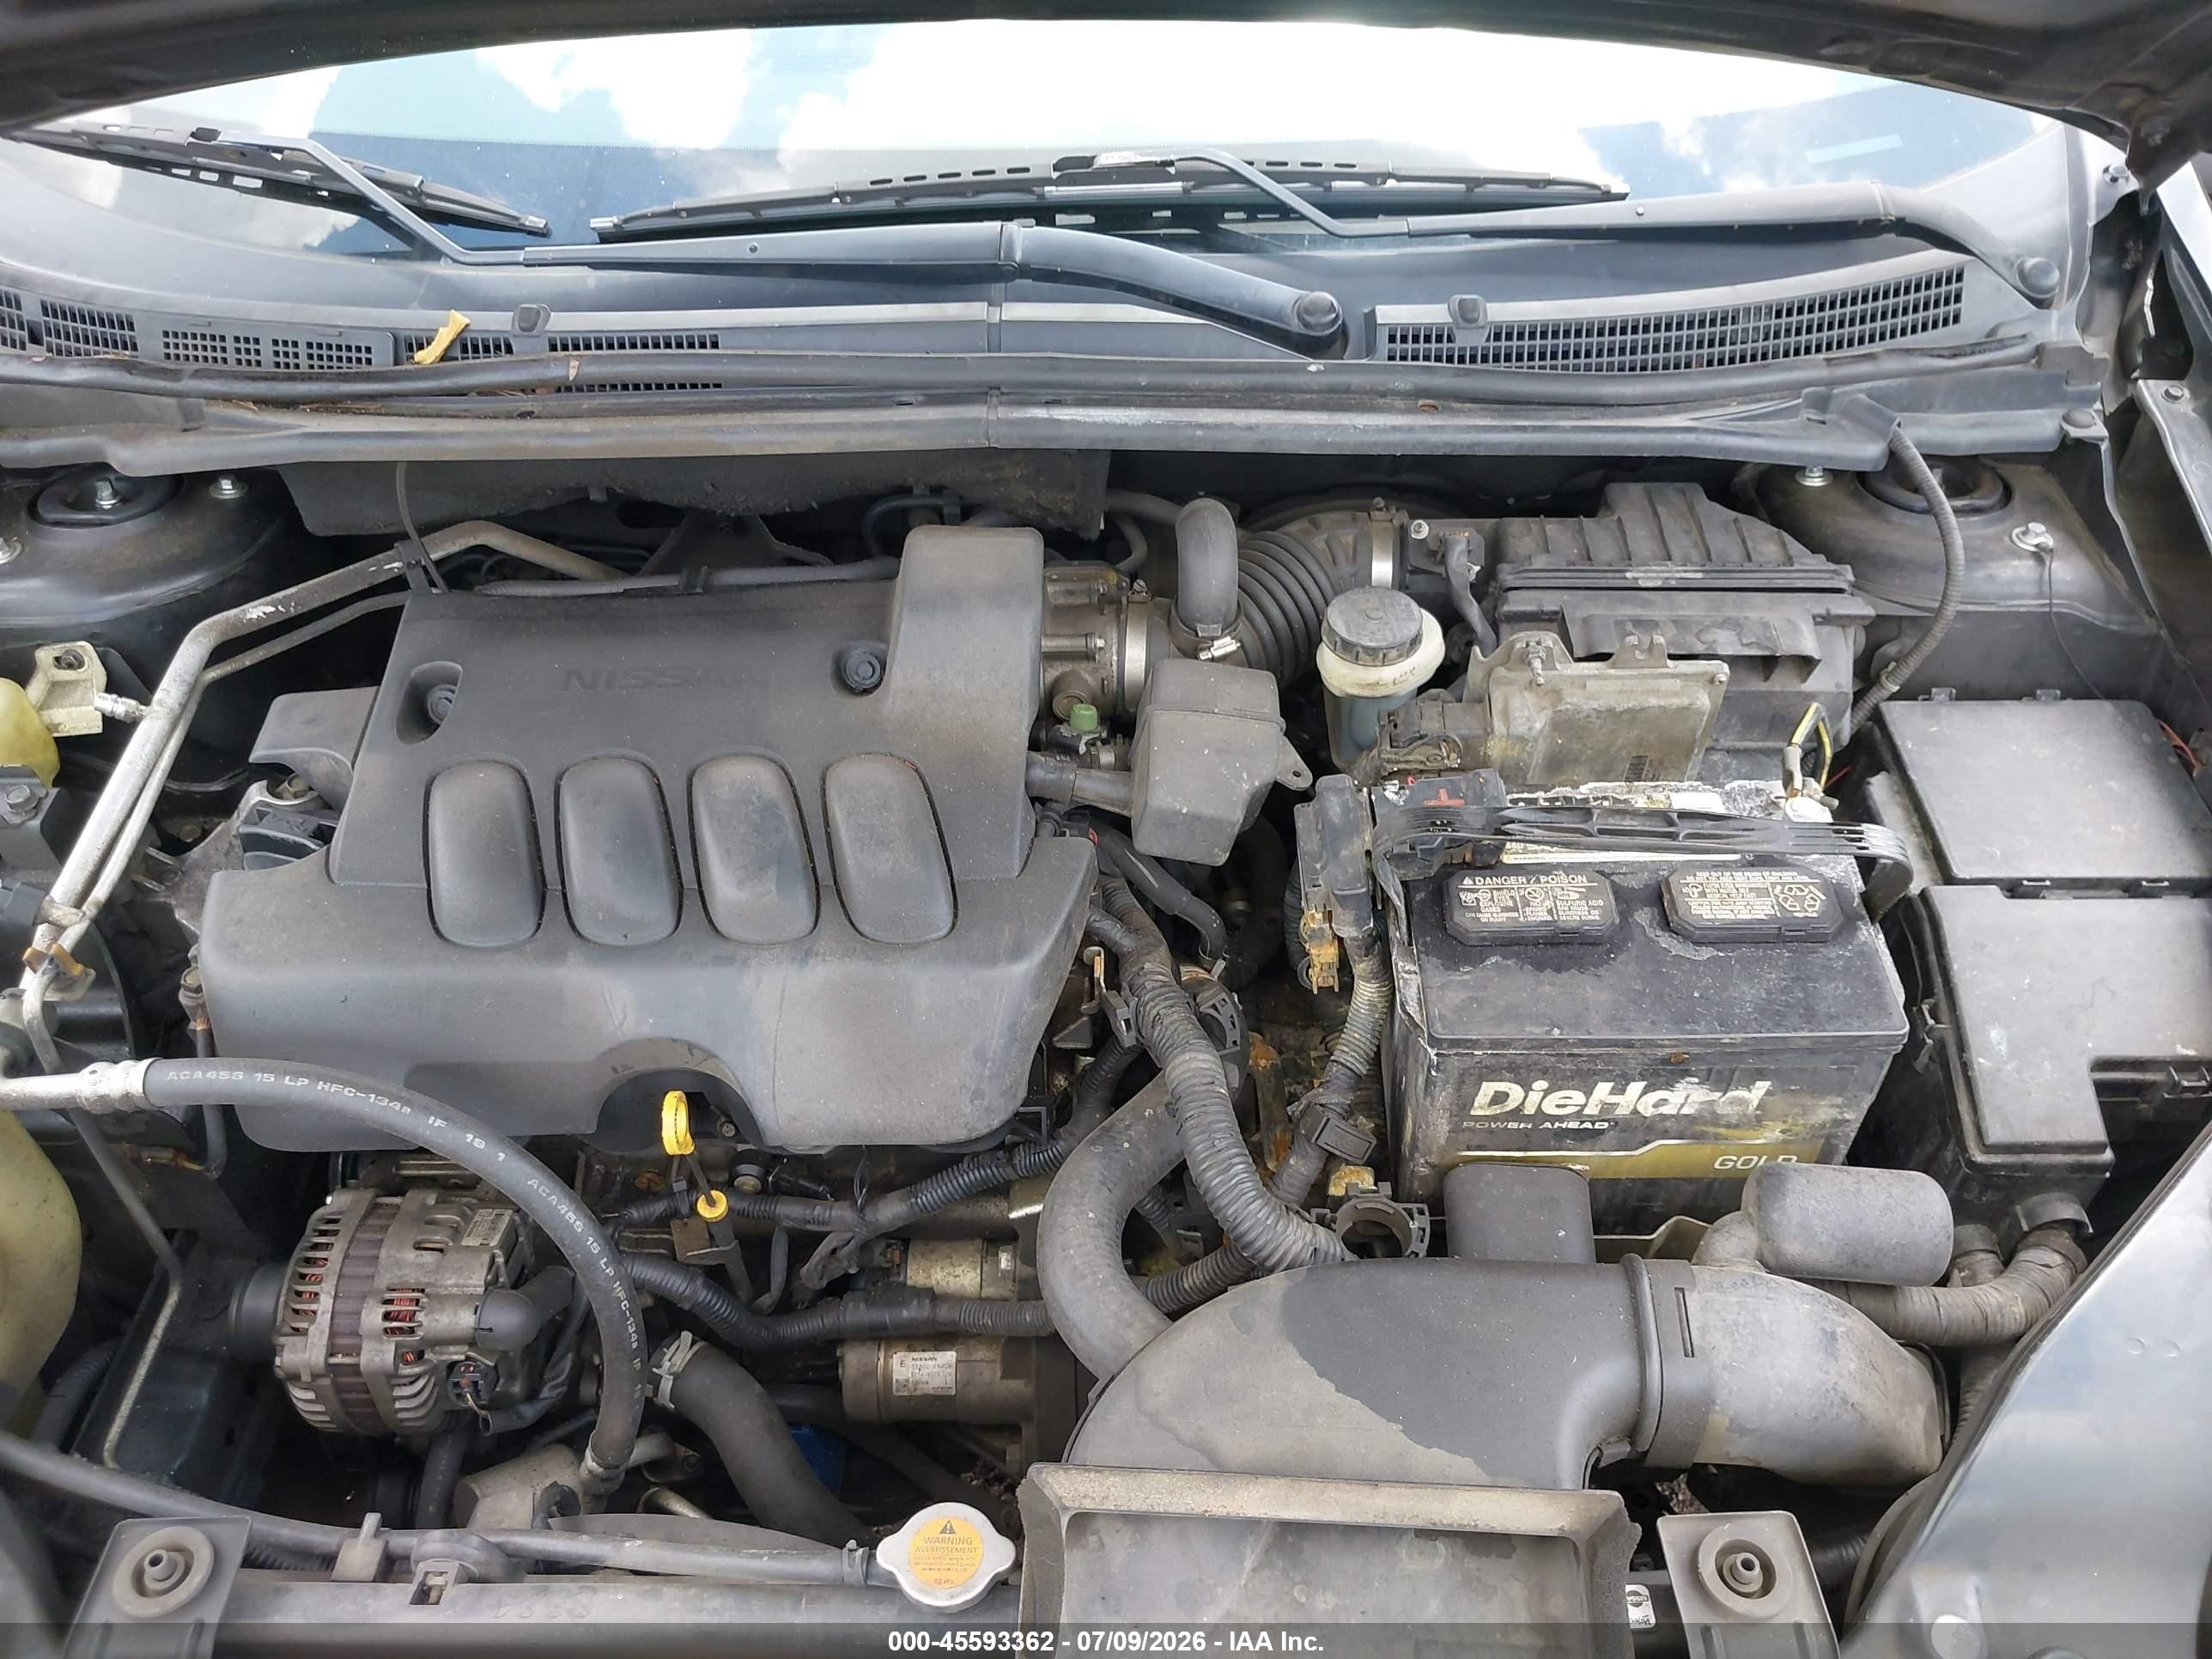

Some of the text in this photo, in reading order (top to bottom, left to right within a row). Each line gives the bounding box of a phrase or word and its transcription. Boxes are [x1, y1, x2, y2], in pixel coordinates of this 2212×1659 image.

[1475, 876, 1527, 885] DANGER
[1539, 874, 1588, 884] POISON
[254, 1072, 275, 1083] 15
[284, 1075, 309, 1086] LP
[316, 1080, 411, 1115] HFC-134a
[428, 1115, 447, 1128] IF
[1469, 1079, 1771, 1116] DieHard
[1539, 1121, 1609, 1129] AHEAD
[586, 1237, 601, 1255] 15
[599, 1256, 615, 1278] LP
[613, 1280, 638, 1349] HFC-134a
[924, 1536, 973, 1546] WARNING
[915, 1546, 977, 1554] AVERTISSEMENT
